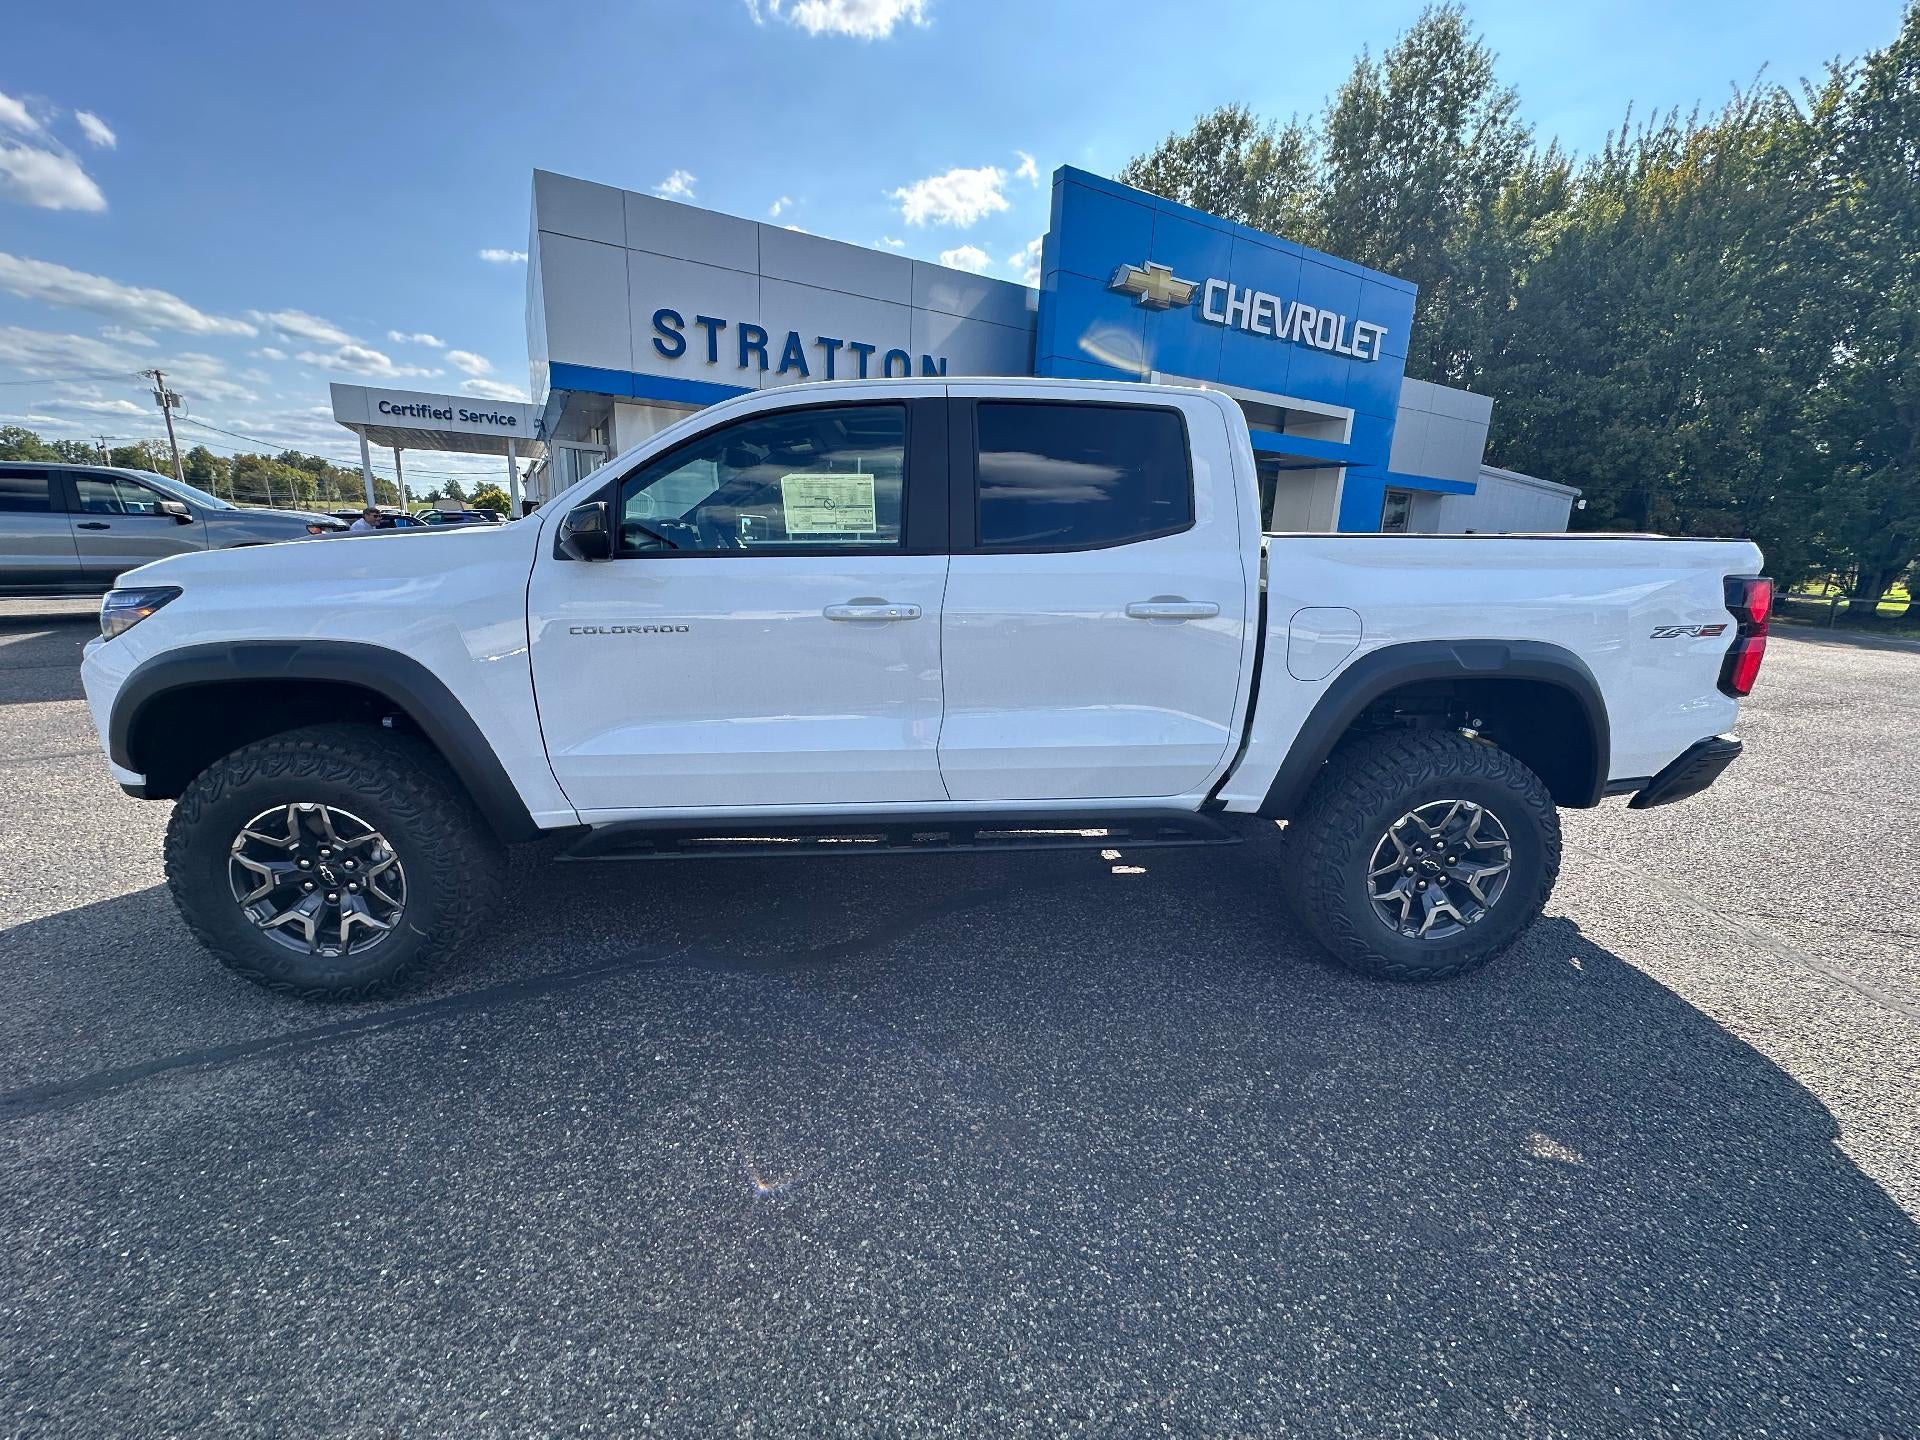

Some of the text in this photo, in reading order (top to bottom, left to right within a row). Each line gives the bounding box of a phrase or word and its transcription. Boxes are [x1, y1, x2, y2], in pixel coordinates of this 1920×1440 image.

[1202, 277, 1388, 361] CHEVROLET
[652, 308, 947, 380] STRATTON
[378, 400, 517, 426] Certified Service
[569, 624, 690, 635] COLORADO
[1649, 624, 1728, 639] ZR2
